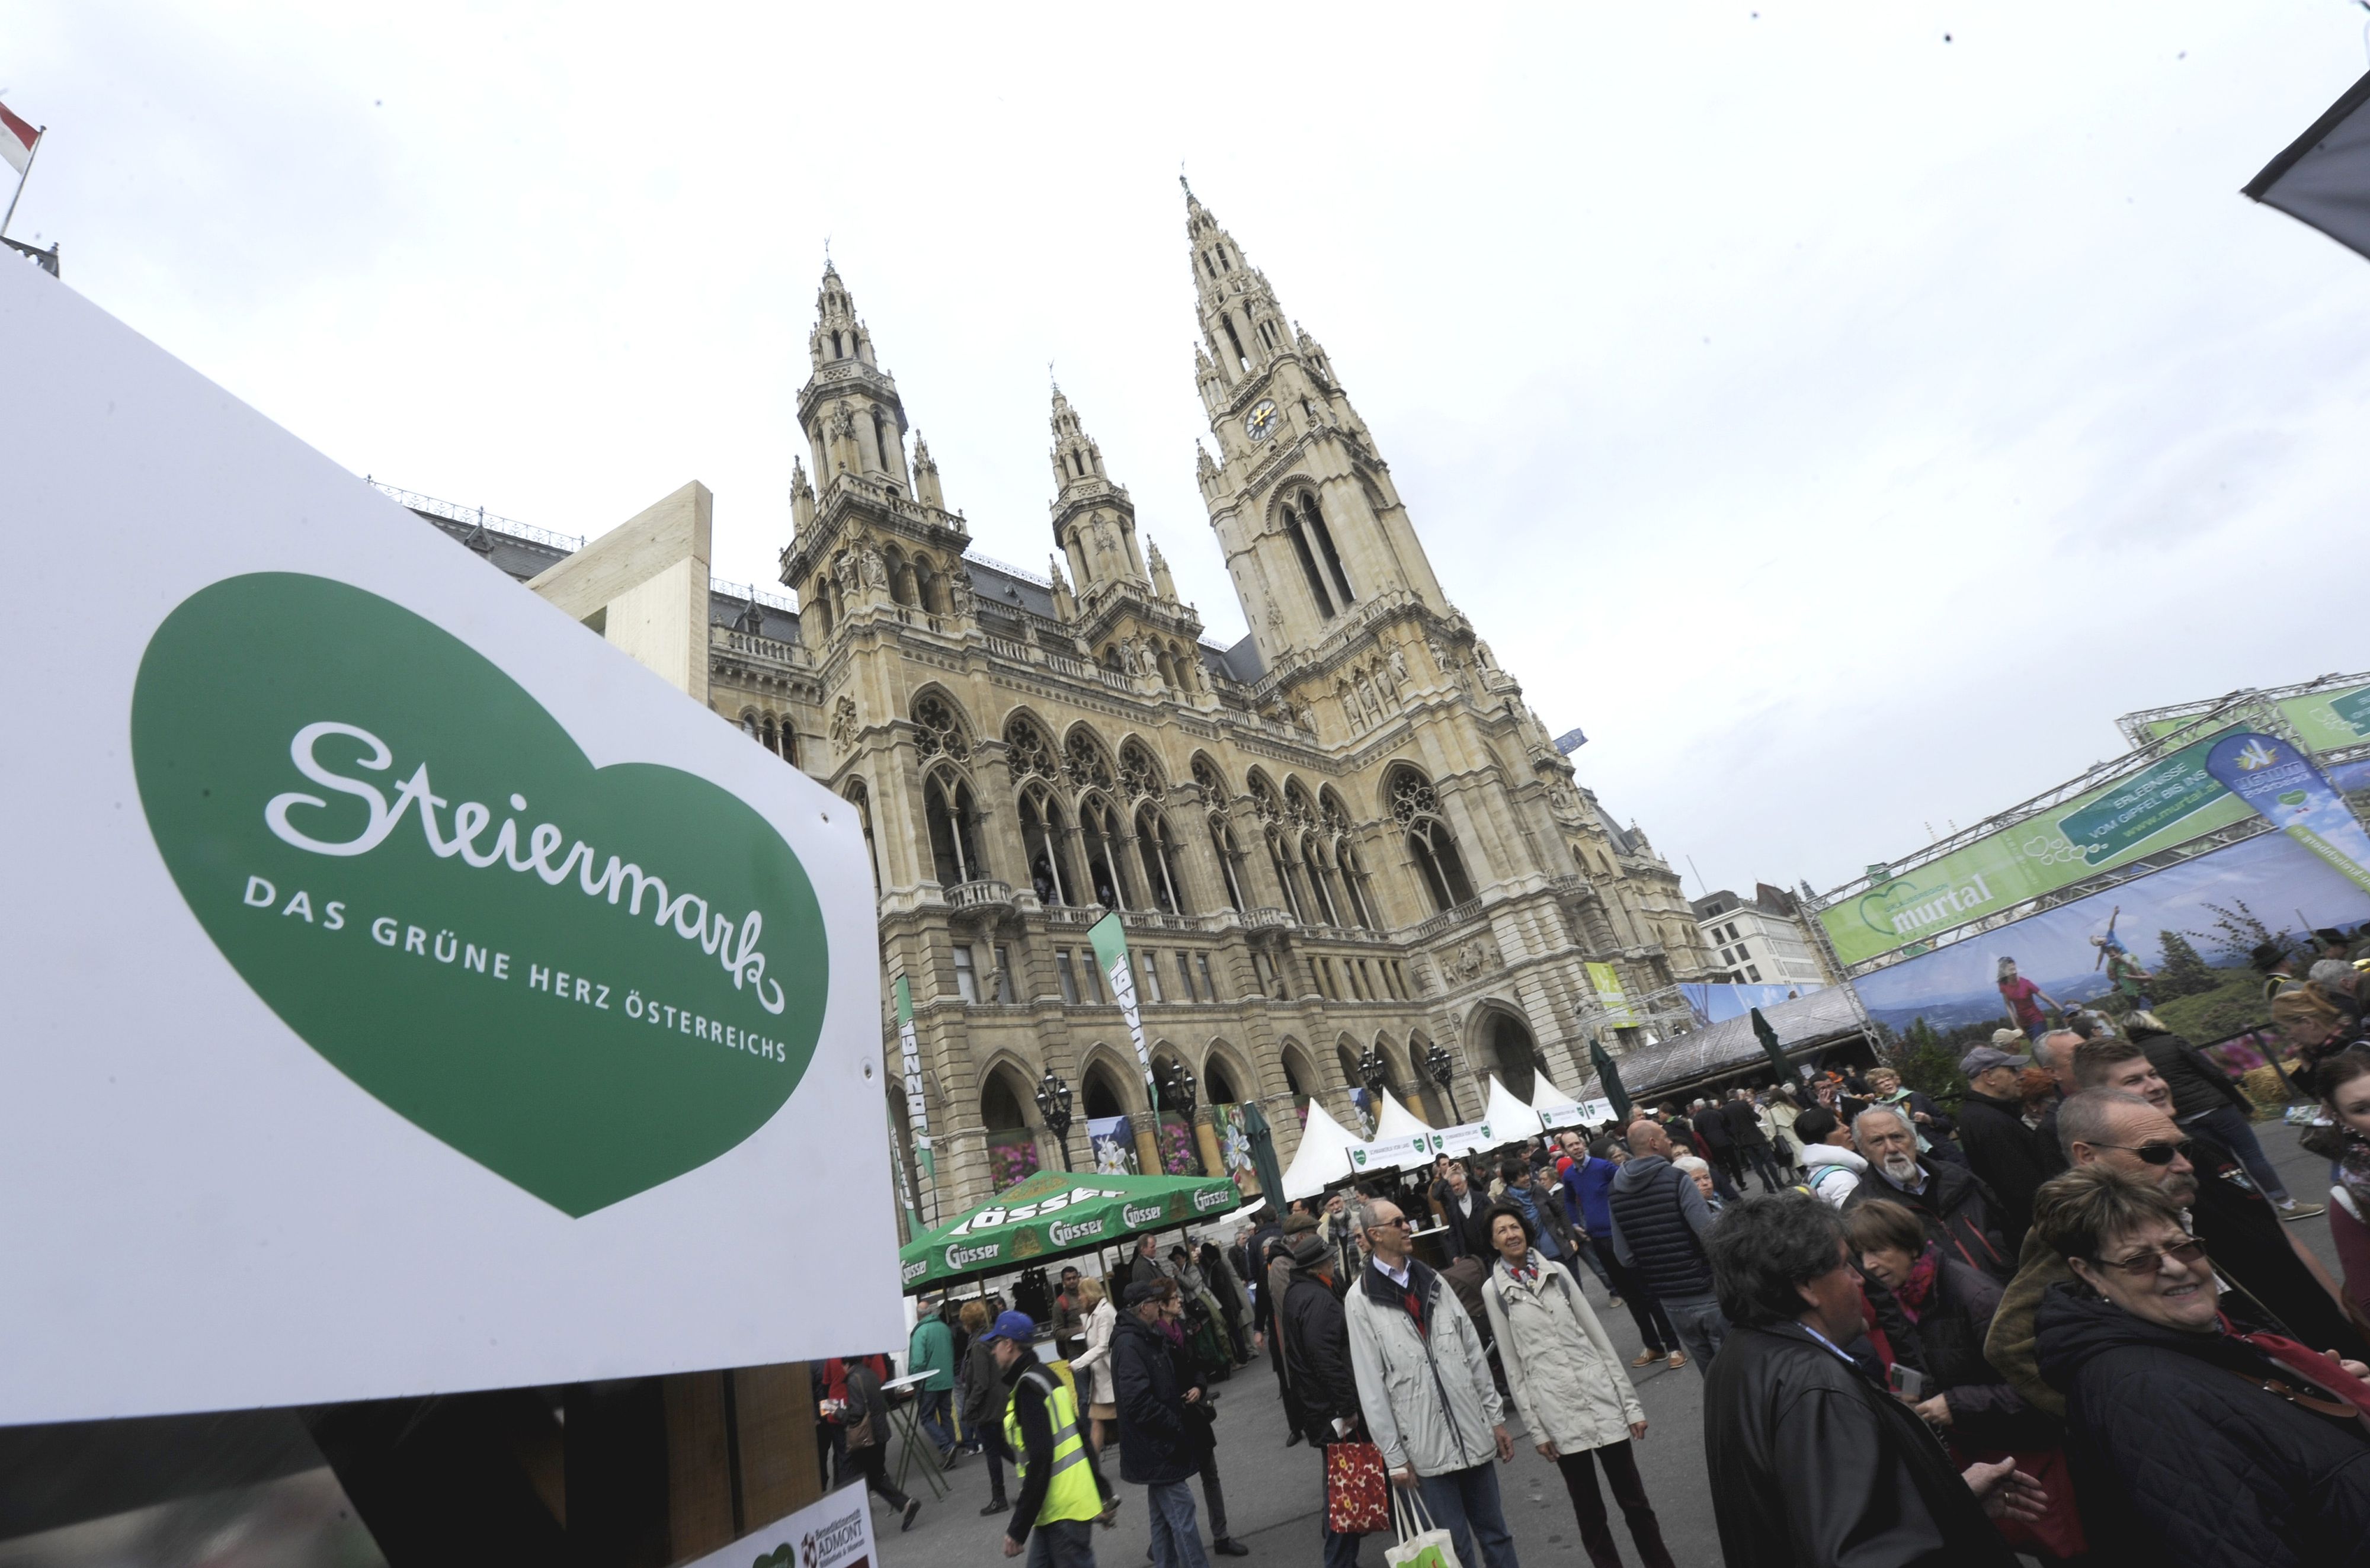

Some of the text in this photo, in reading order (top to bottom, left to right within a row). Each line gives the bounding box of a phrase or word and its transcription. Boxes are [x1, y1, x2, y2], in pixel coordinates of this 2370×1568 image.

[2088, 769, 2208, 838] VOM GIPFEL BIS INS
[2113, 762, 2188, 810] ERLEBNISSE
[265, 721, 785, 1015] Steiermark
[1891, 873, 1994, 934] murtal
[244, 875, 786, 1062] DAS GRÜNE HERZ ÖSTERREICHS
[1123, 1203, 1161, 1229] Gösser
[1194, 1188, 1228, 1212] Gösser
[1049, 1219, 1103, 1246] Gösser
[945, 1243, 1000, 1269] Gösser
[819, 1518, 862, 1559] ADMONT
